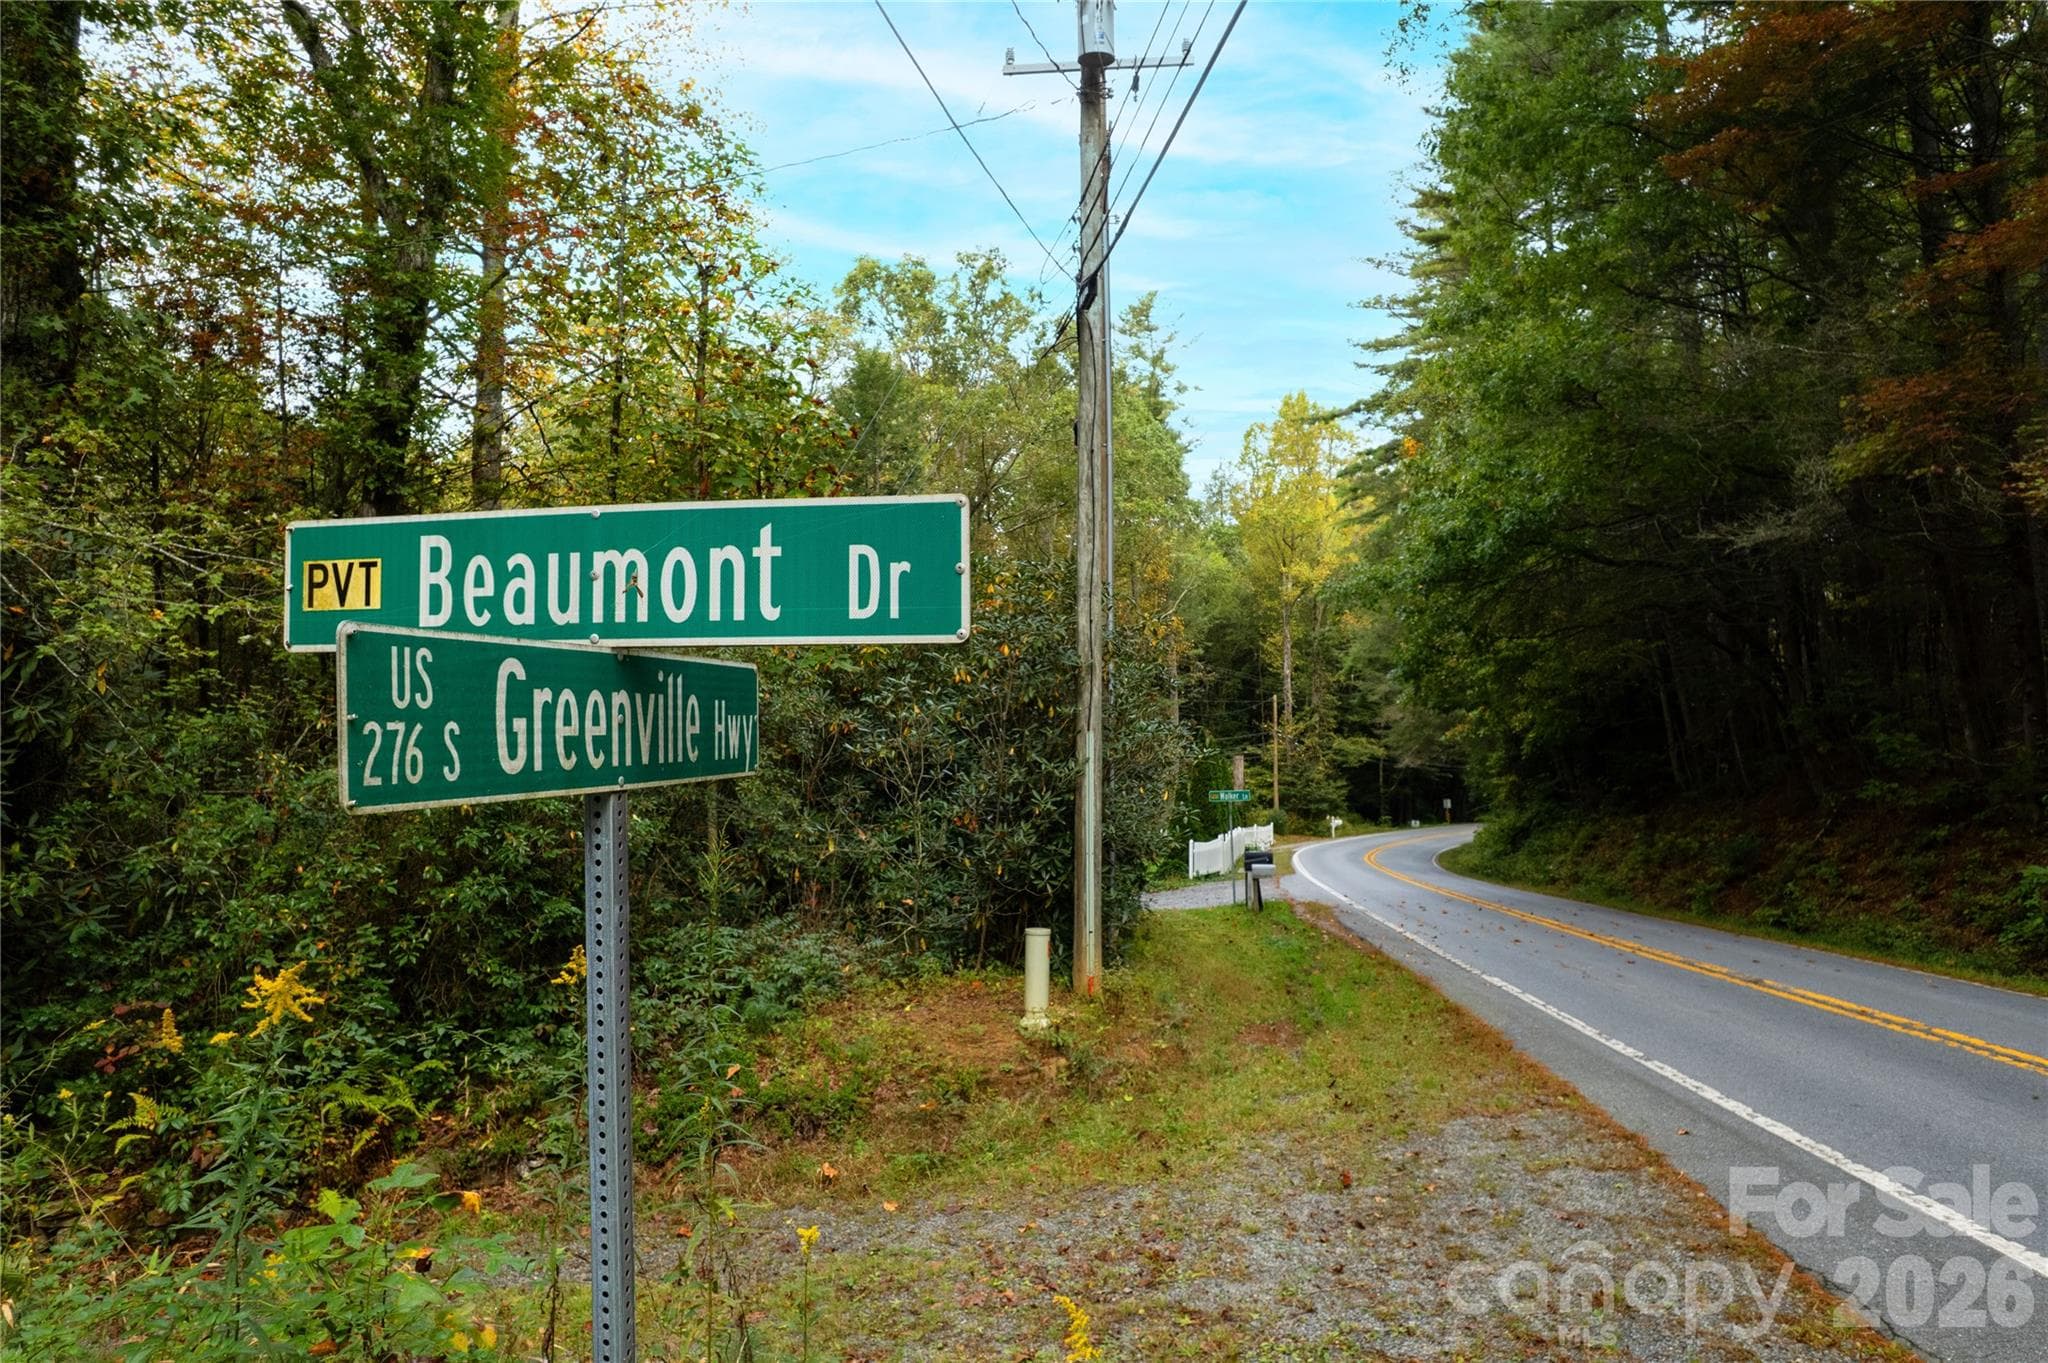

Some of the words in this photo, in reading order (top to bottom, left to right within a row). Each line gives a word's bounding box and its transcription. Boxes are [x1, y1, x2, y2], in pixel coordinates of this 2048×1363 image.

[307, 560, 378, 608] PVT
[419, 522, 782, 628] Beaumont
[849, 544, 912, 619] Dr
[391, 646, 433, 710] US
[496, 657, 700, 775] Greenville
[714, 699, 754, 772] Hwy
[363, 721, 424, 786] 276
[443, 721, 461, 782] S
